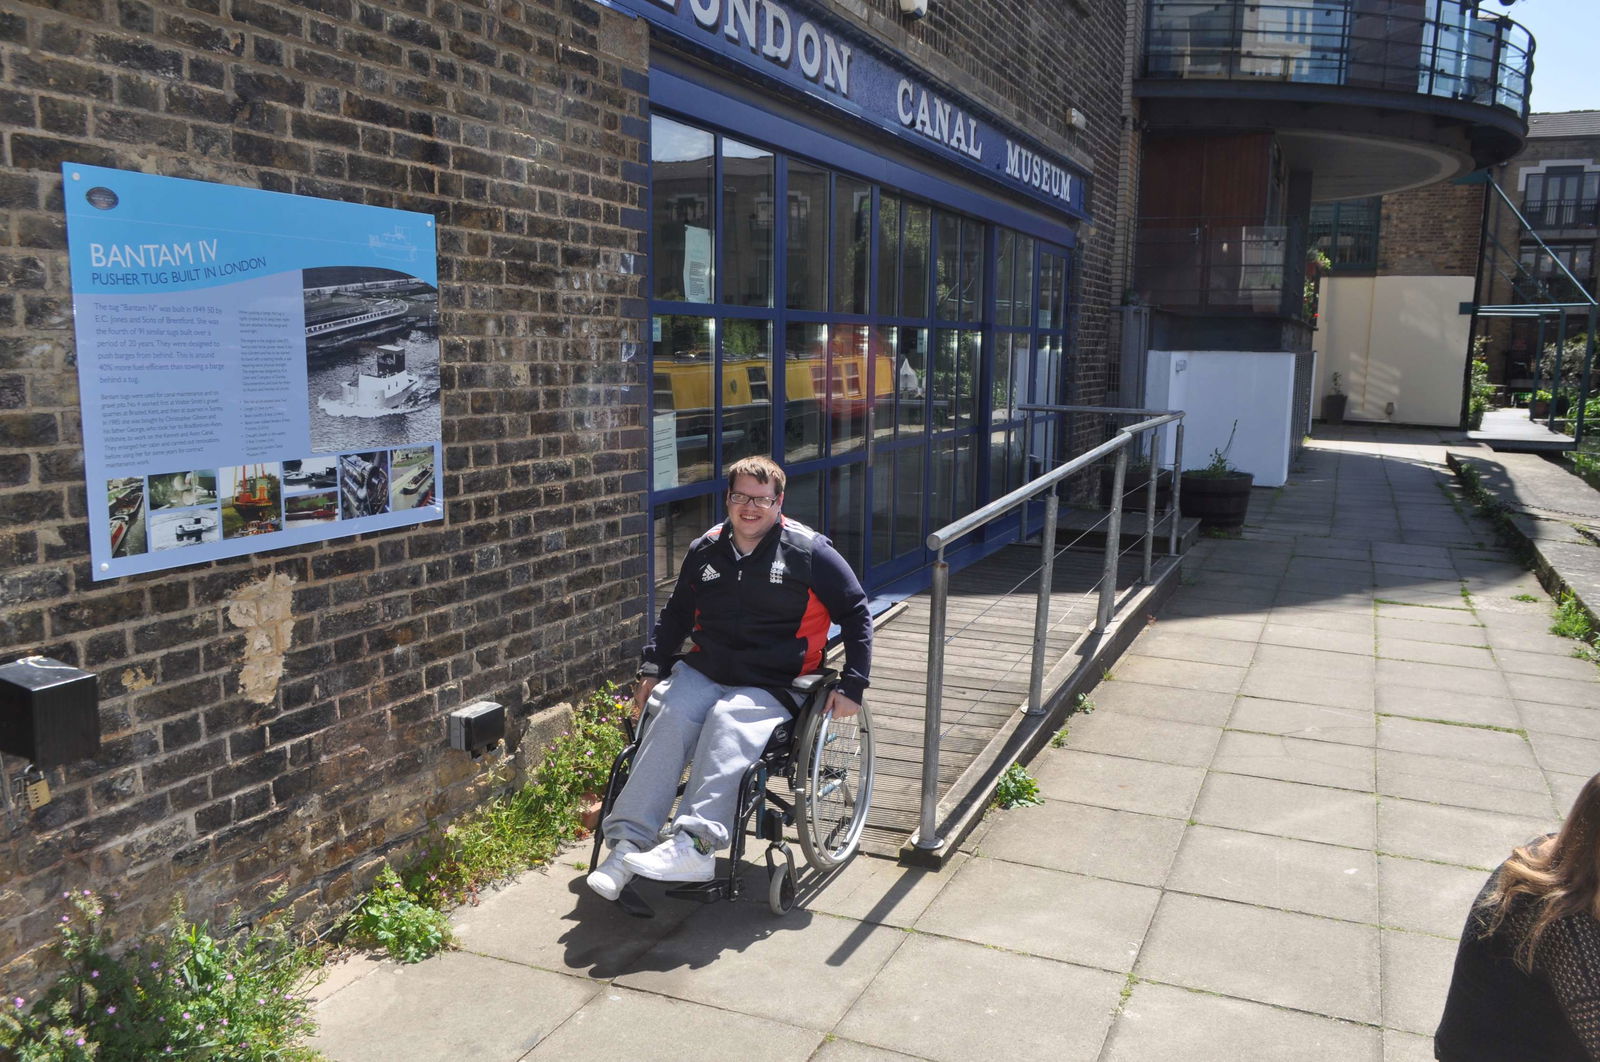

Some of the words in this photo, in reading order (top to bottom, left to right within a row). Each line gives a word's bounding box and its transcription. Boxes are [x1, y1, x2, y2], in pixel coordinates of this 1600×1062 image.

[655, 0, 851, 95] NDON
[897, 79, 982, 160] CANAL
[1005, 139, 1072, 202] MUSEUM
[90, 242, 194, 268] BANTAM
[198, 239, 217, 263] IV
[92, 272, 139, 286] PUSHER
[141, 271, 168, 285] TUG
[172, 268, 200, 283] BUILT
[204, 266, 217, 279] IN
[219, 256, 267, 276] LONDON
